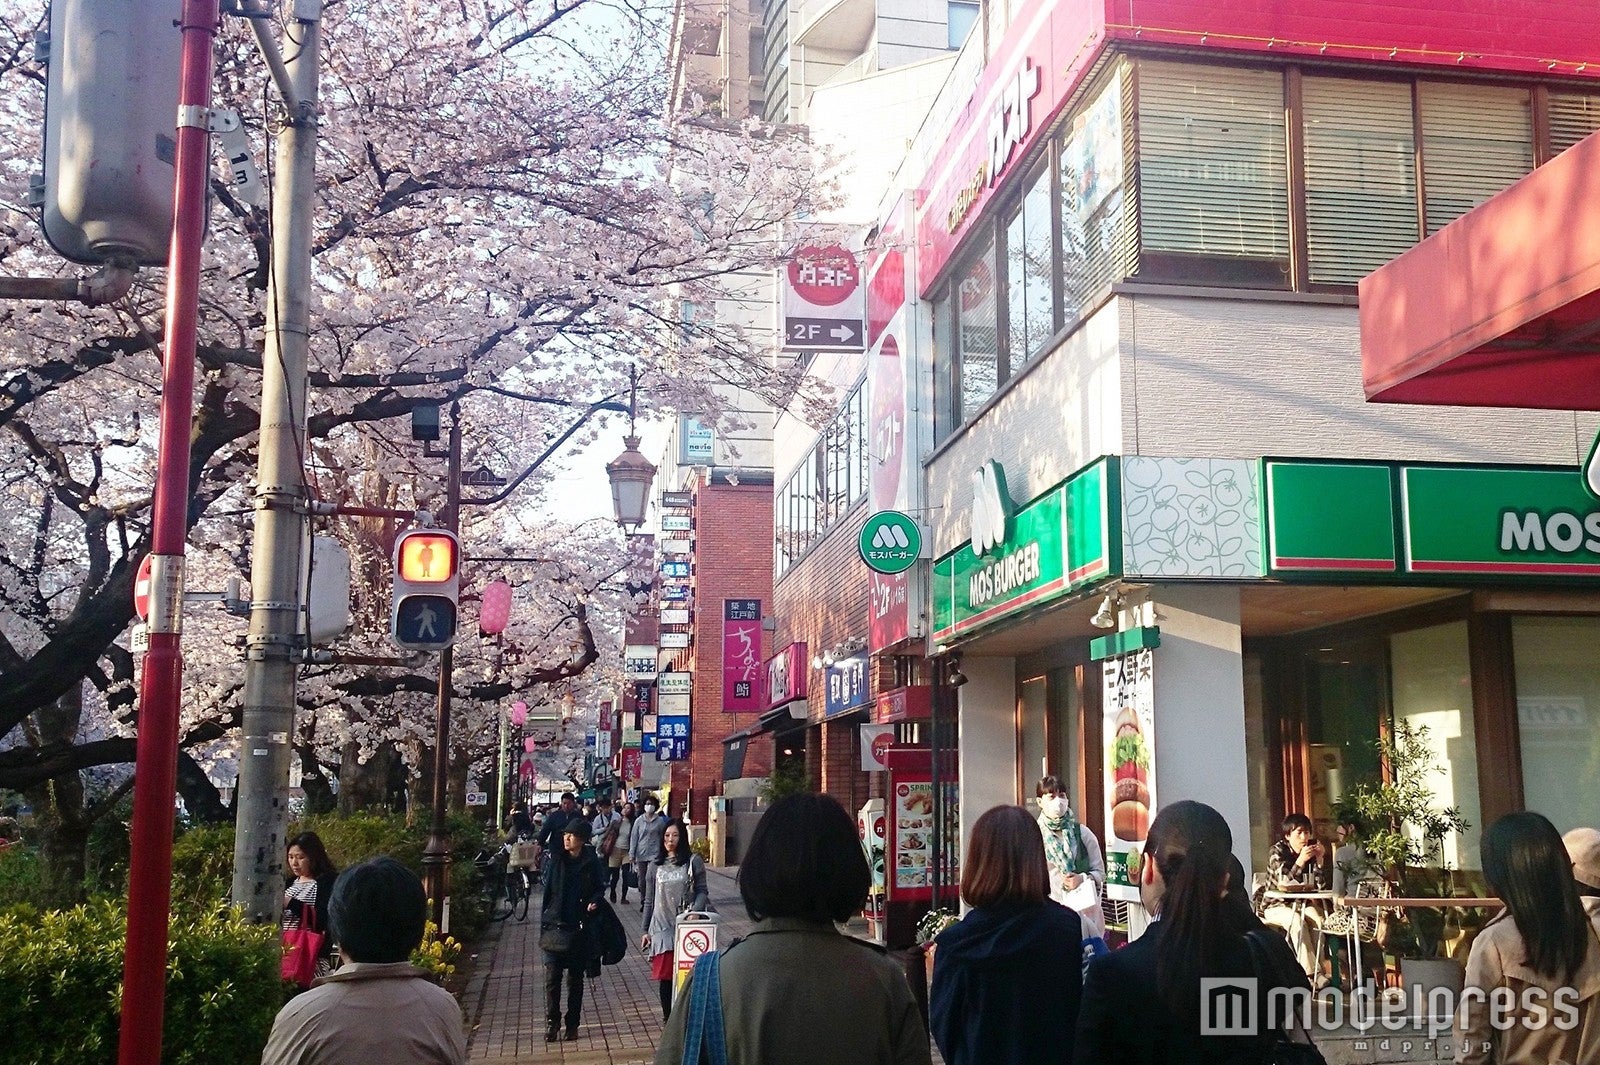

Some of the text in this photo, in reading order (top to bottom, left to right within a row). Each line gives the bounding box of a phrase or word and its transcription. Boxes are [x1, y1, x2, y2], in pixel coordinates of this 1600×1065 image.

[793, 324, 821, 340] 2F
[868, 551, 914, 560] モスバーガー
[970, 542, 1040, 608] MOS BURGER
[731, 610, 756, 620] 江戸前
[660, 723, 687, 737] 森塾
